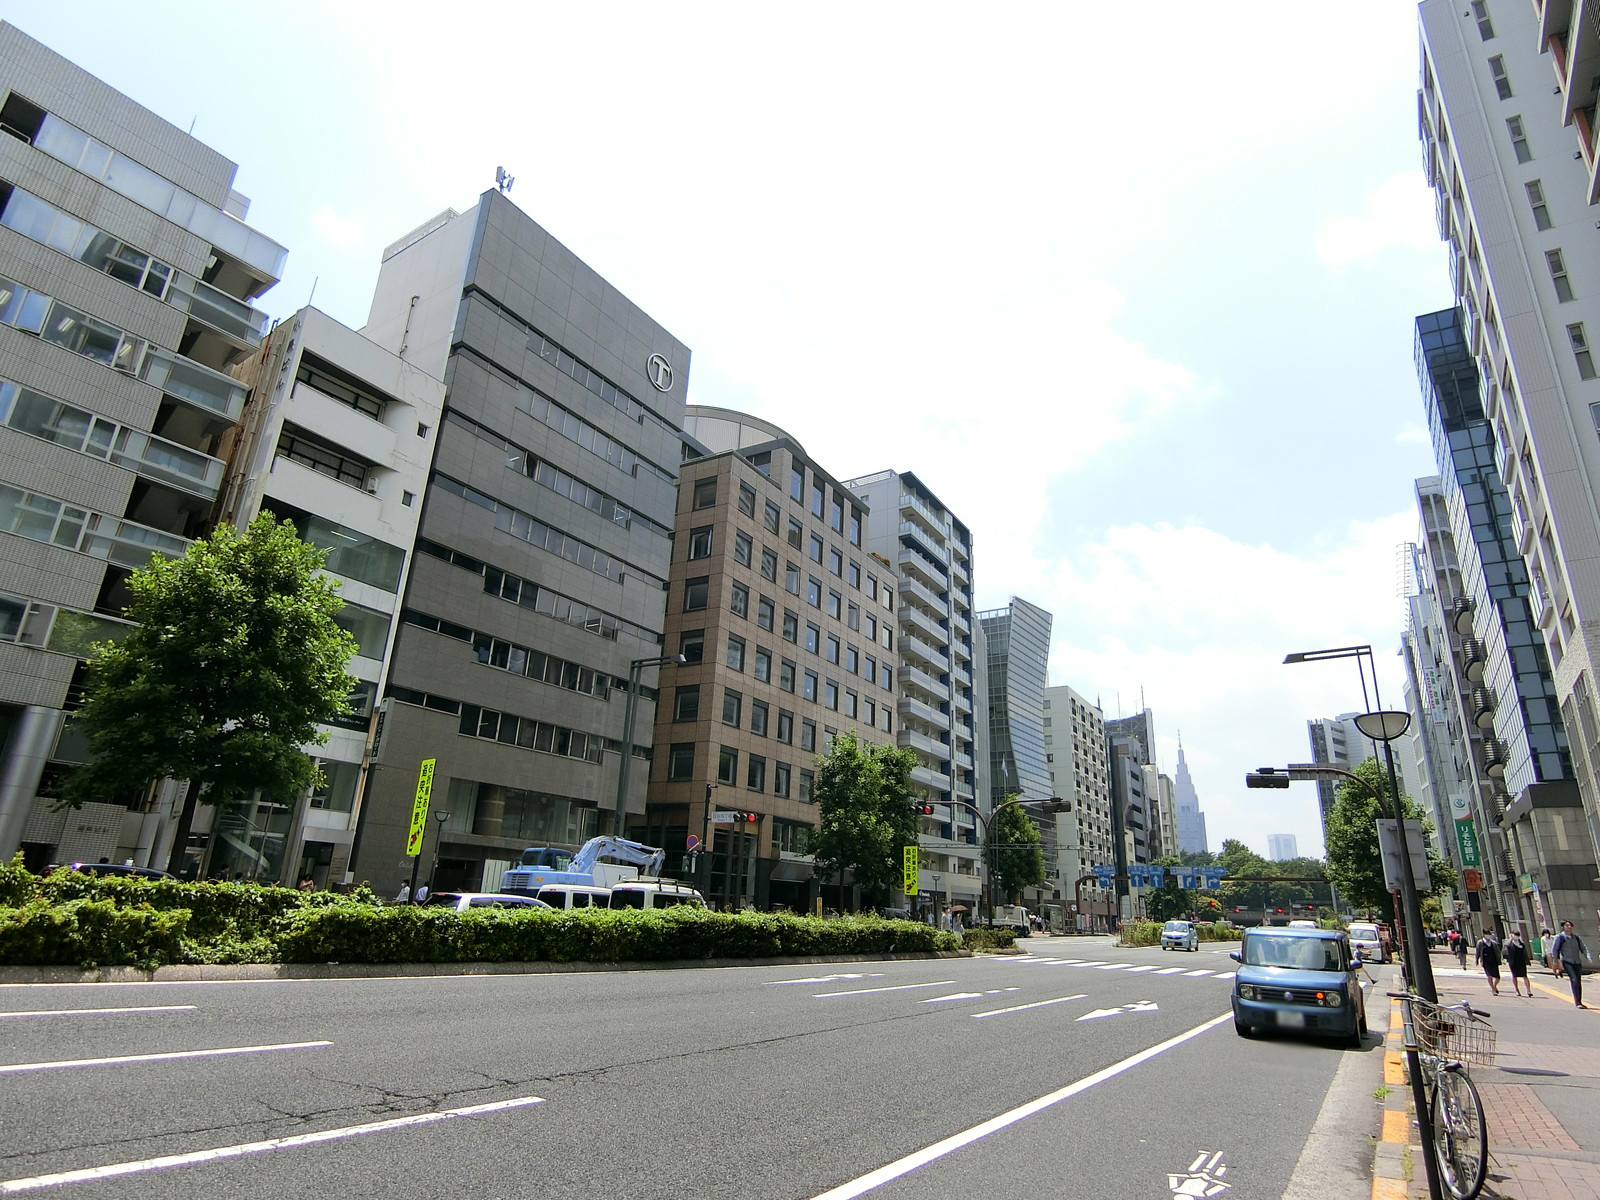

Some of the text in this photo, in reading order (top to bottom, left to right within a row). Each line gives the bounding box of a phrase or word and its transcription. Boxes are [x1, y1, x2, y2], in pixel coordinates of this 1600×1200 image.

[652, 356, 671, 389] T
[1461, 825, 1475, 862] りそな銀行
